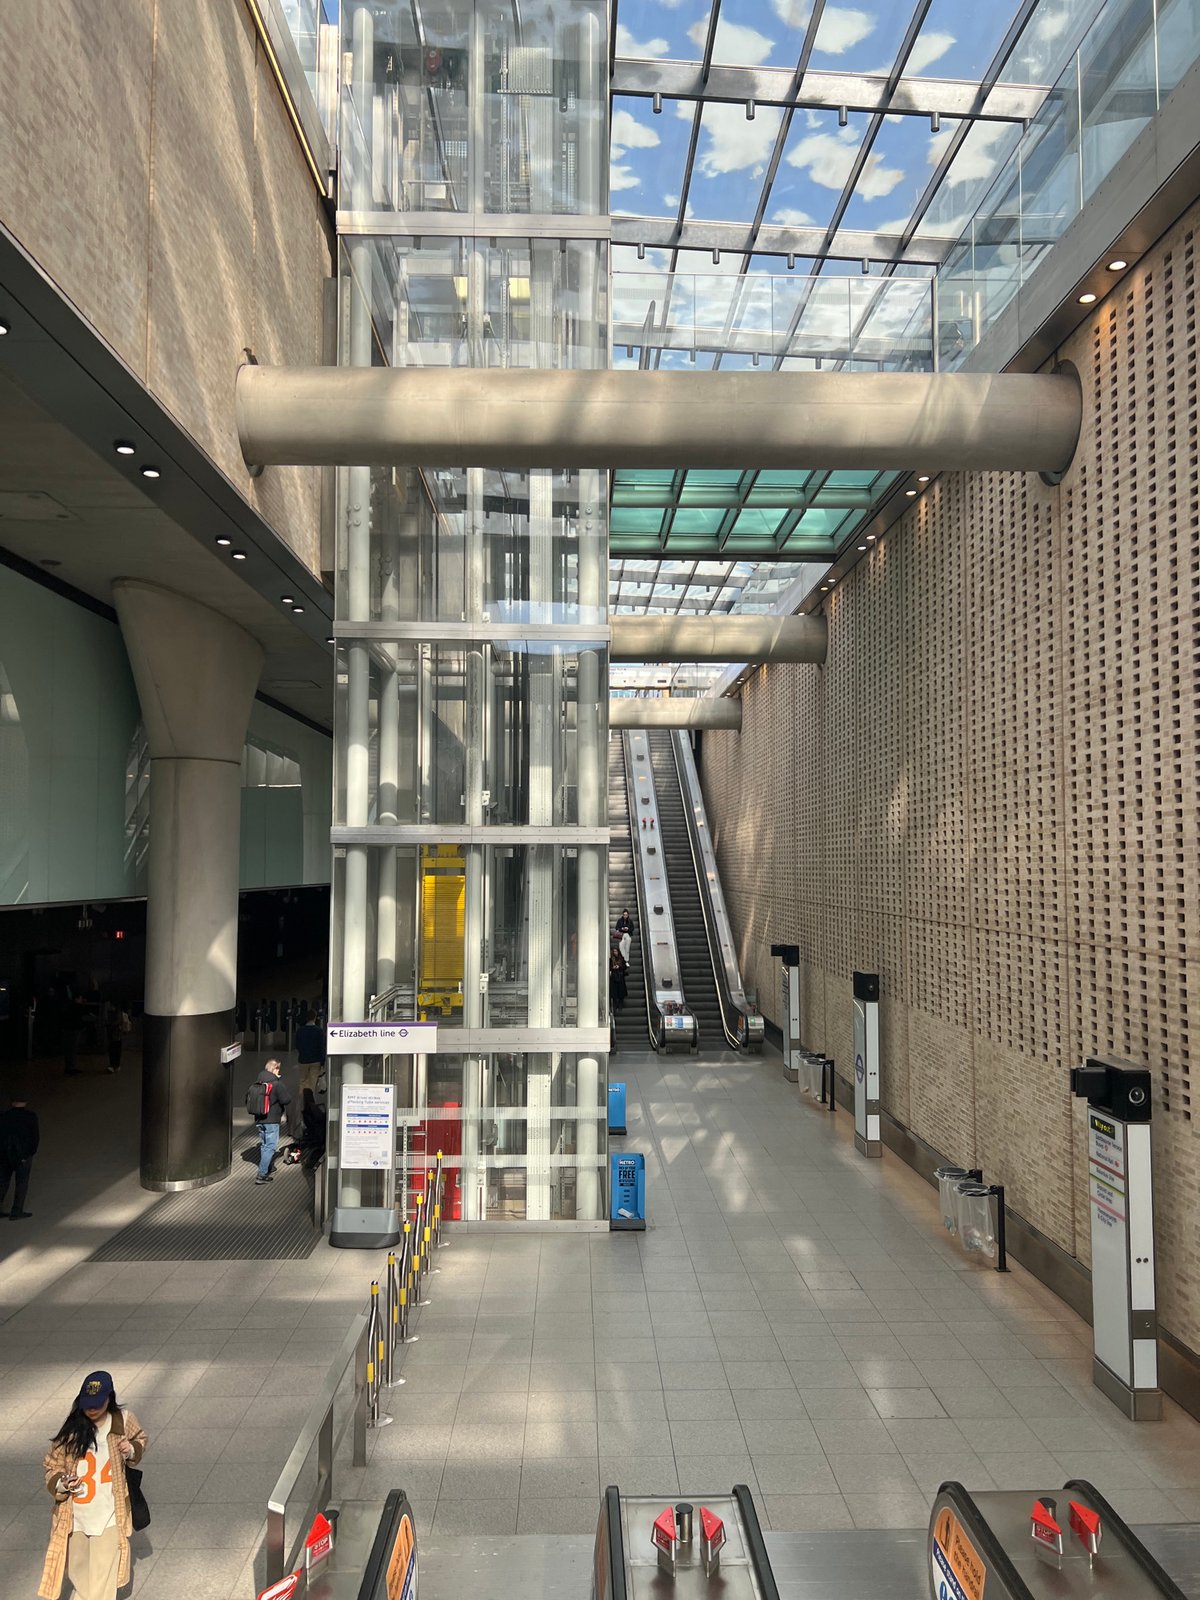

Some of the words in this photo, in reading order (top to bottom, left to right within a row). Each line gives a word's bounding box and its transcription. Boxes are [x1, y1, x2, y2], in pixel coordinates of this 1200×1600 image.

[339, 1029, 378, 1038] Elizabeth
[380, 1029, 396, 1038] line
[618, 1170, 636, 1179] FREE
